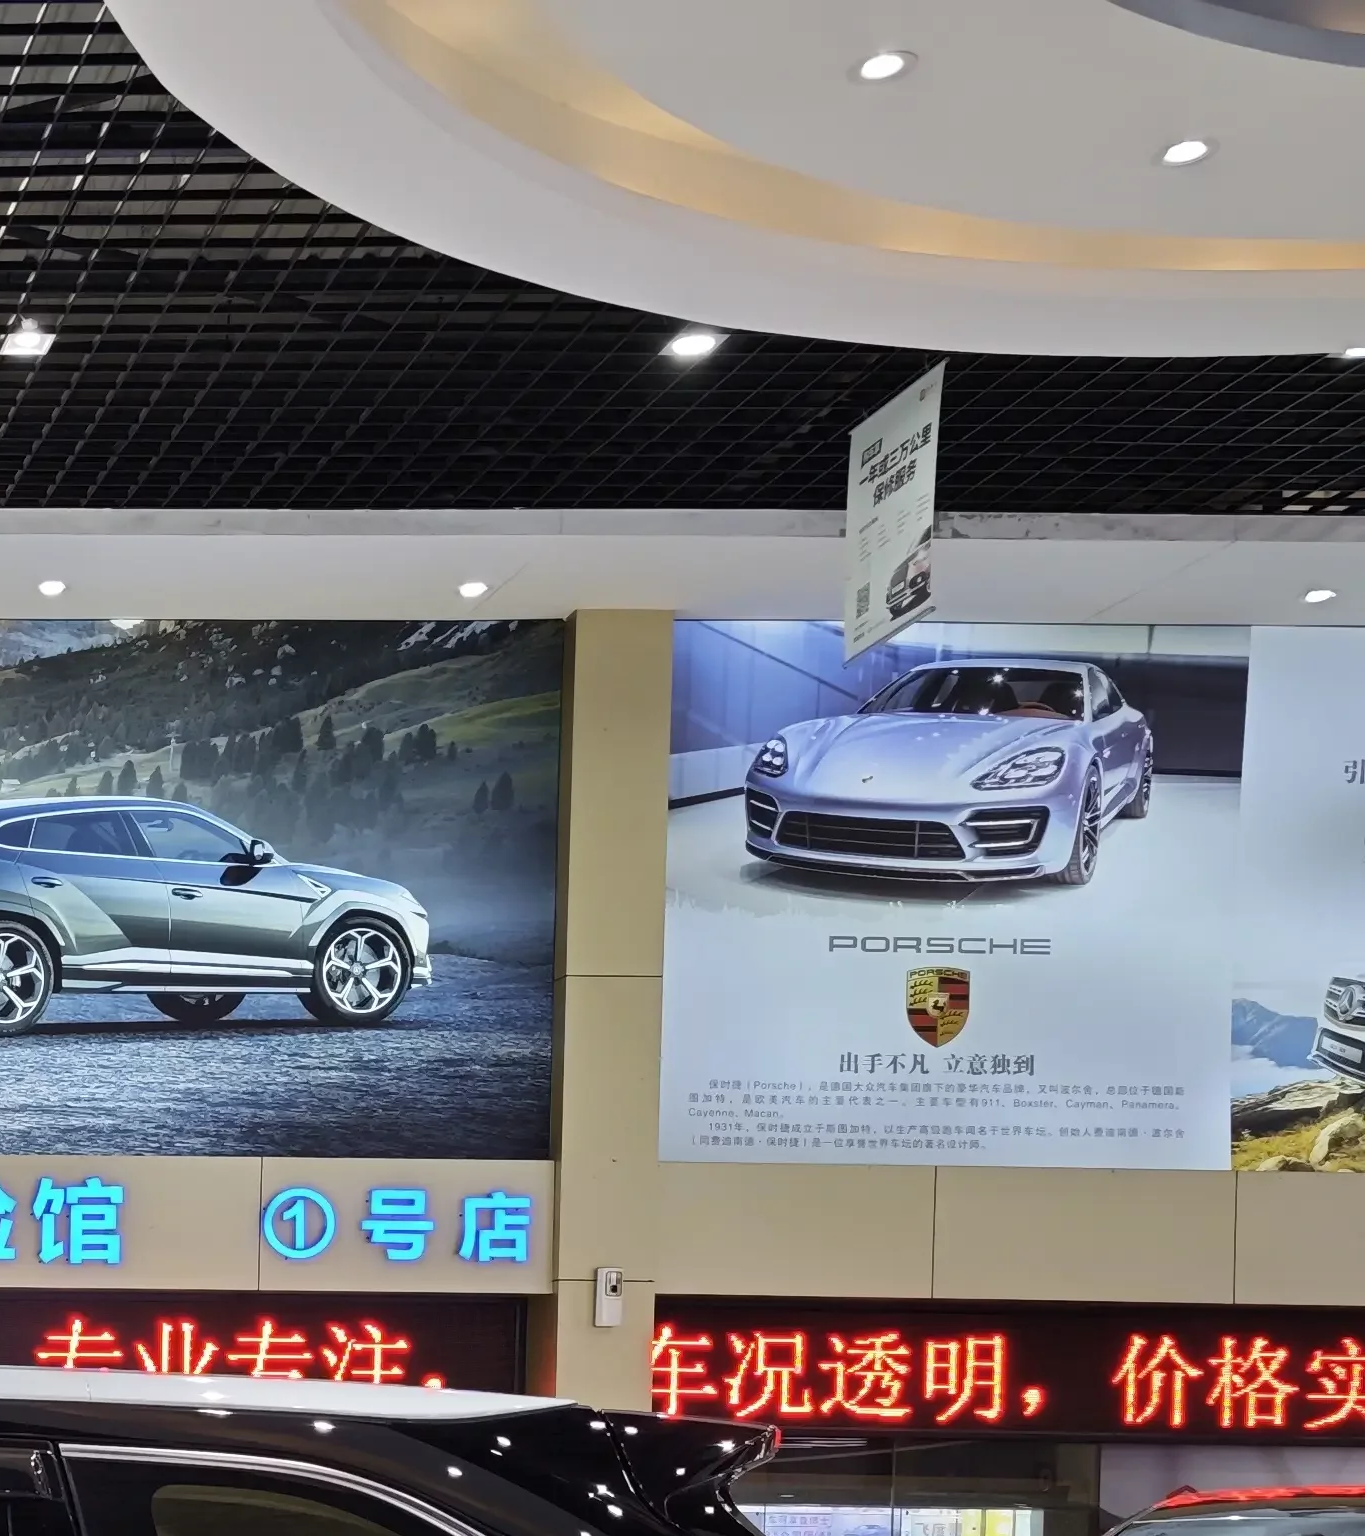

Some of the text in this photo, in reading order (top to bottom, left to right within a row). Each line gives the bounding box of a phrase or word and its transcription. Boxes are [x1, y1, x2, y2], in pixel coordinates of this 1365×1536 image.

[828, 935, 1052, 955] PORSCHE
[909, 968, 968, 979] PORSCHE
[839, 1051, 1036, 1077] 出手不凡 立意独到
